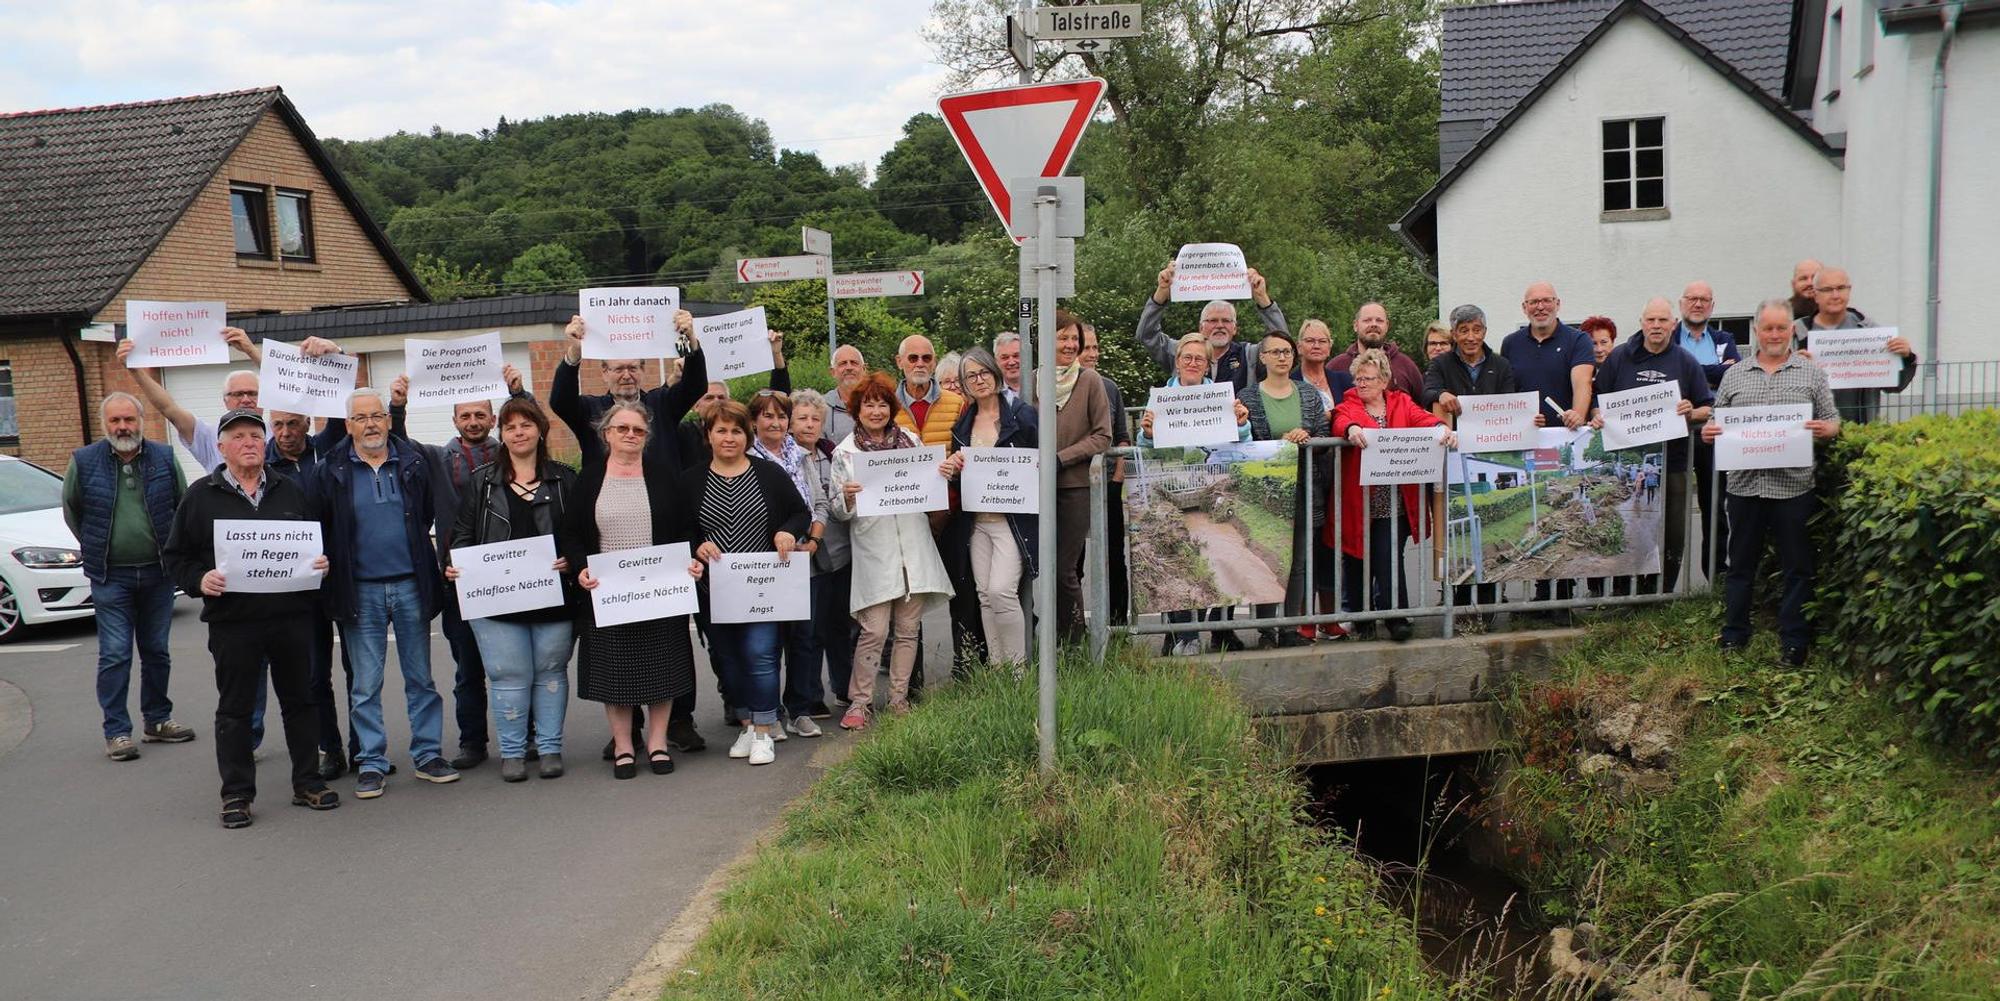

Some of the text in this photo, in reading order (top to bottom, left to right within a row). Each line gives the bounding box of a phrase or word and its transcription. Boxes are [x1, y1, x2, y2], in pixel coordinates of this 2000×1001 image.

[1051, 11, 1130, 31] Talstraße
[589, 296, 670, 307] Ein Jahr danach
[143, 309, 209, 321] Hoffen hilft
[608, 315, 655, 324] Nichts ist
[703, 318, 752, 333] Gewitter und
[160, 327, 193, 337] nicht!
[610, 332, 654, 342] passiert!
[719, 335, 742, 344] Regen
[150, 345, 207, 356] Handeln!
[422, 344, 487, 357] Die Prognosen
[269, 348, 352, 370] Bürokratie lähmt!
[426, 358, 486, 370] werden nicht
[724, 362, 745, 370] Angst
[278, 367, 339, 384] Wir brauchen
[441, 372, 474, 381] besser!
[279, 382, 337, 398] Hilfe. Jetzt!!!
[419, 384, 498, 397] Handelt endlich!!
[1157, 390, 1230, 403] Bürokratie lähmt!
[1606, 390, 1673, 409] Lasst uns nicht
[1184, 405, 1222, 414] brauchen
[1472, 400, 1527, 411] Hoffen hilft
[1635, 407, 1663, 418] Regen
[1169, 417, 1221, 428] Hilfe. Jetzt!!!
[1485, 416, 1512, 425] nicht!
[1724, 413, 1803, 424] Ein Jahr danach
[1627, 420, 1661, 435] stehen!
[1476, 432, 1521, 442] Handeln!
[1741, 430, 1772, 439] Nichts
[1742, 444, 1785, 455] passiert!
[868, 457, 908, 466] Durchlass
[918, 454, 933, 462] 125
[885, 483, 920, 492] tickende
[879, 495, 928, 506] Zeitbombe!
[981, 496, 1025, 504] Zeitbombe!
[226, 530, 313, 541] Lasst uns nicht
[242, 549, 298, 561] im Regen
[482, 549, 527, 562] Gewitter
[618, 556, 662, 568] Gewitter
[730, 560, 790, 569] Gewitter und
[247, 568, 293, 578] stehen!
[747, 576, 775, 585] Regen
[466, 578, 554, 598] schlaflose Nächte
[601, 586, 689, 605] schlaflose Nächte
[749, 606, 774, 614] Angst
